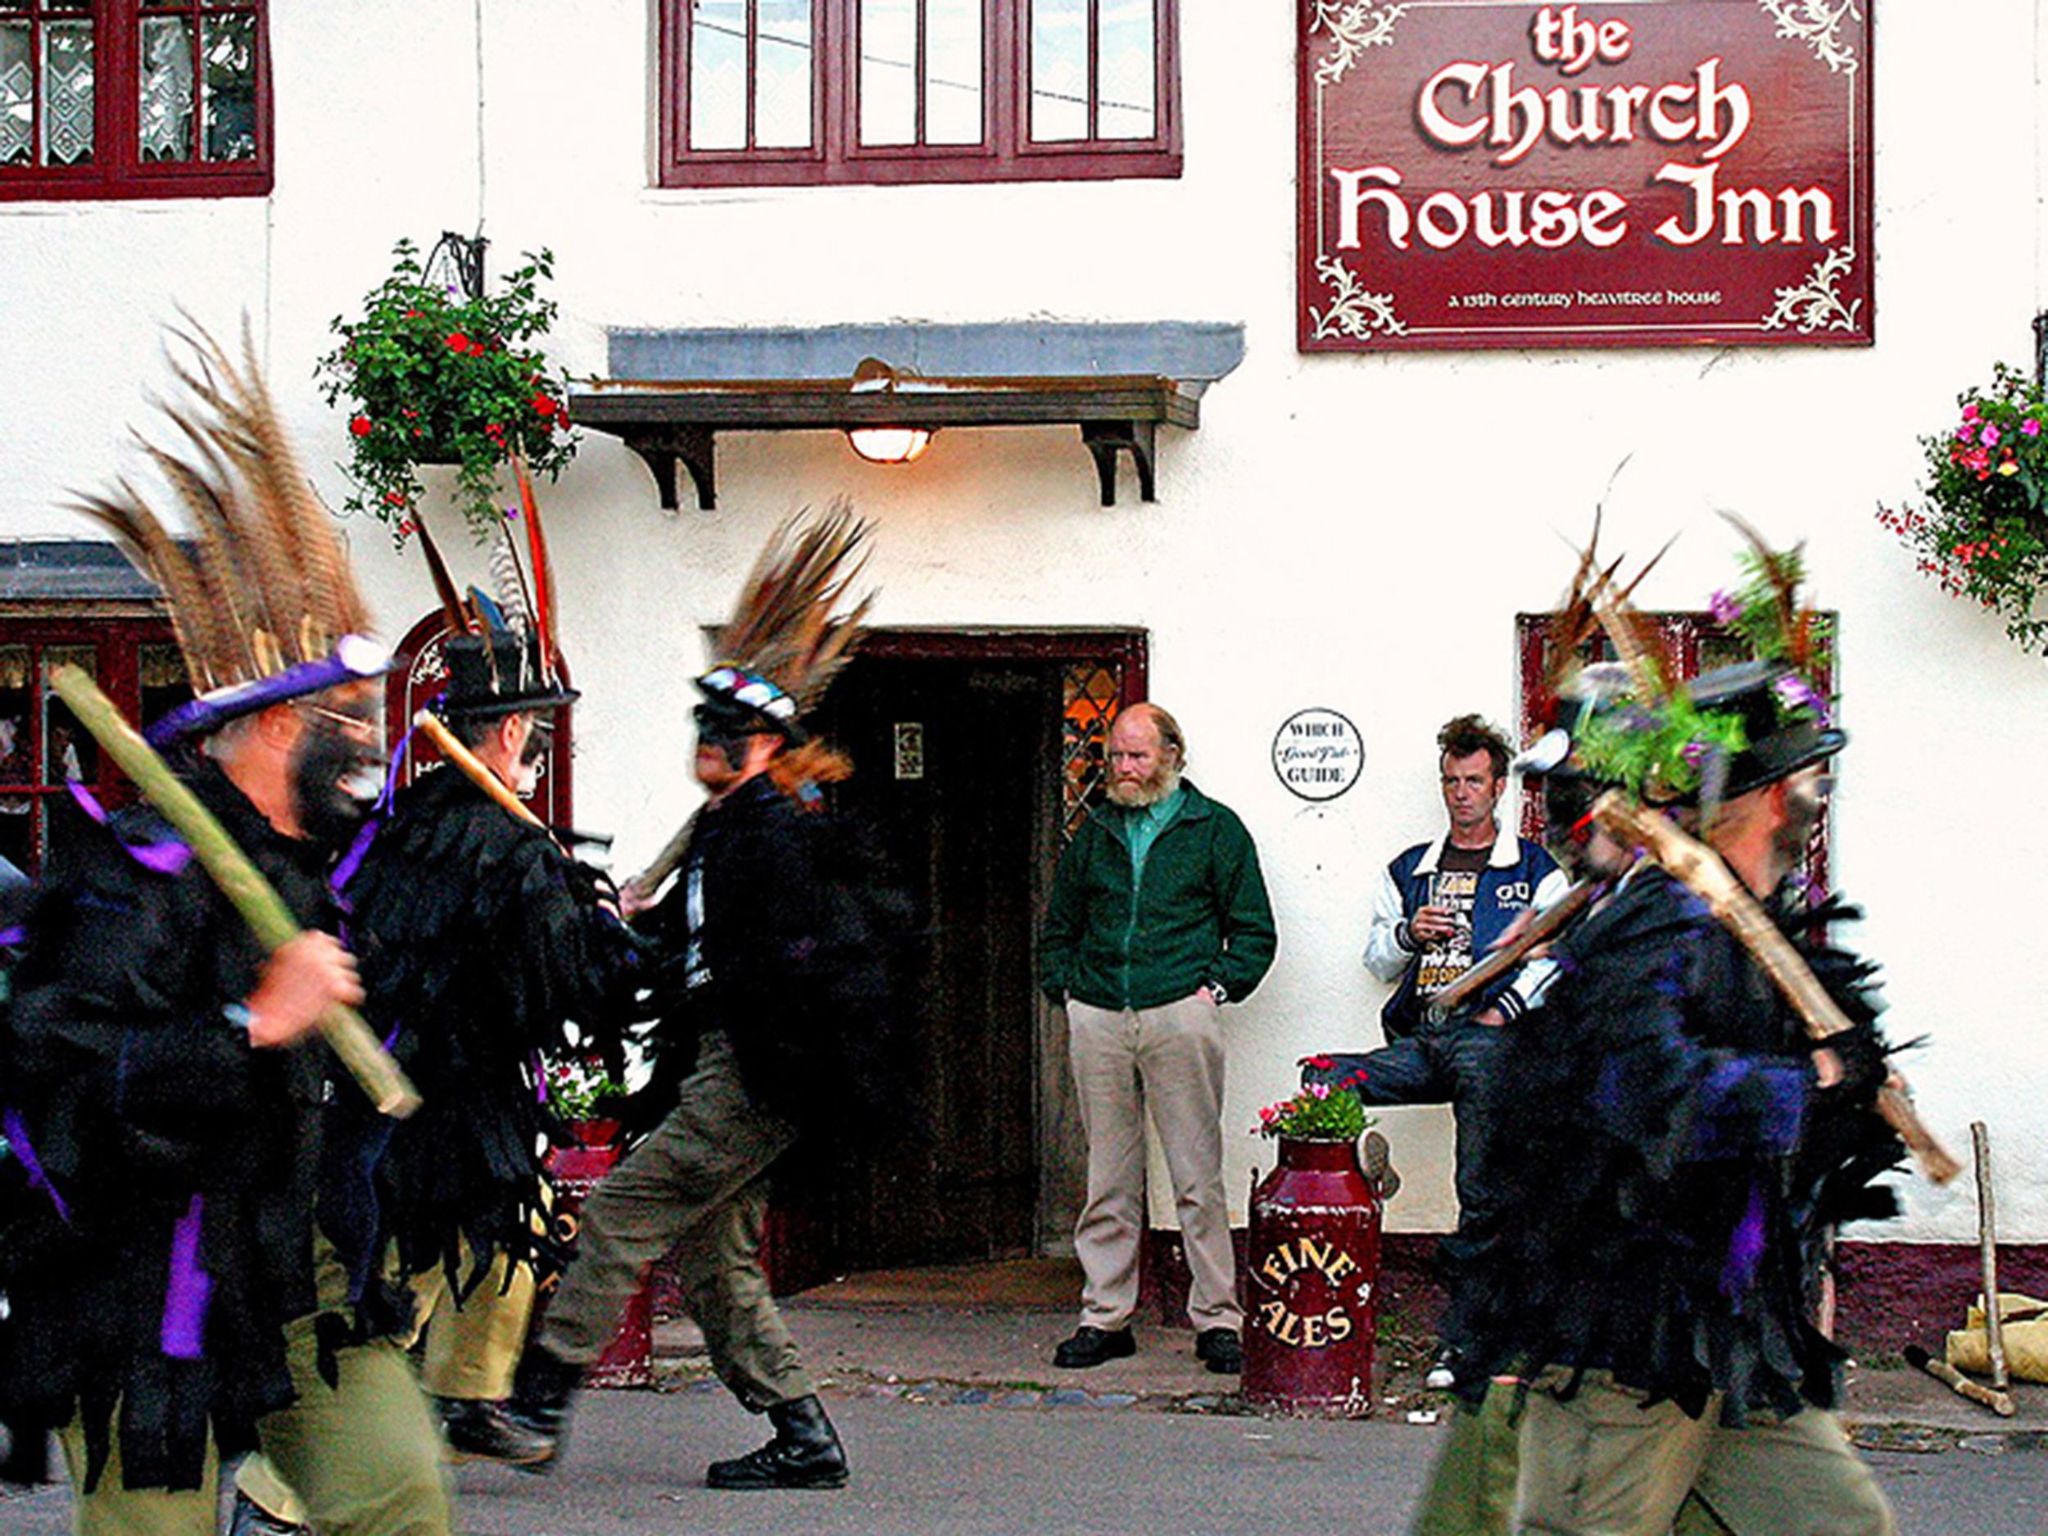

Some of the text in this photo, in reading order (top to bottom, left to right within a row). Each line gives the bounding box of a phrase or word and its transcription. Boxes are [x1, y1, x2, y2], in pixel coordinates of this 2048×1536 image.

[1533, 5, 1631, 72] the
[1418, 58, 1751, 164] Church
[1653, 162, 1837, 245] Inn
[1289, 722, 1344, 737] WHICH
[1286, 766, 1346, 783] GUIDE
[1262, 1236, 1356, 1287] FINE
[1259, 1299, 1352, 1348] ALES
